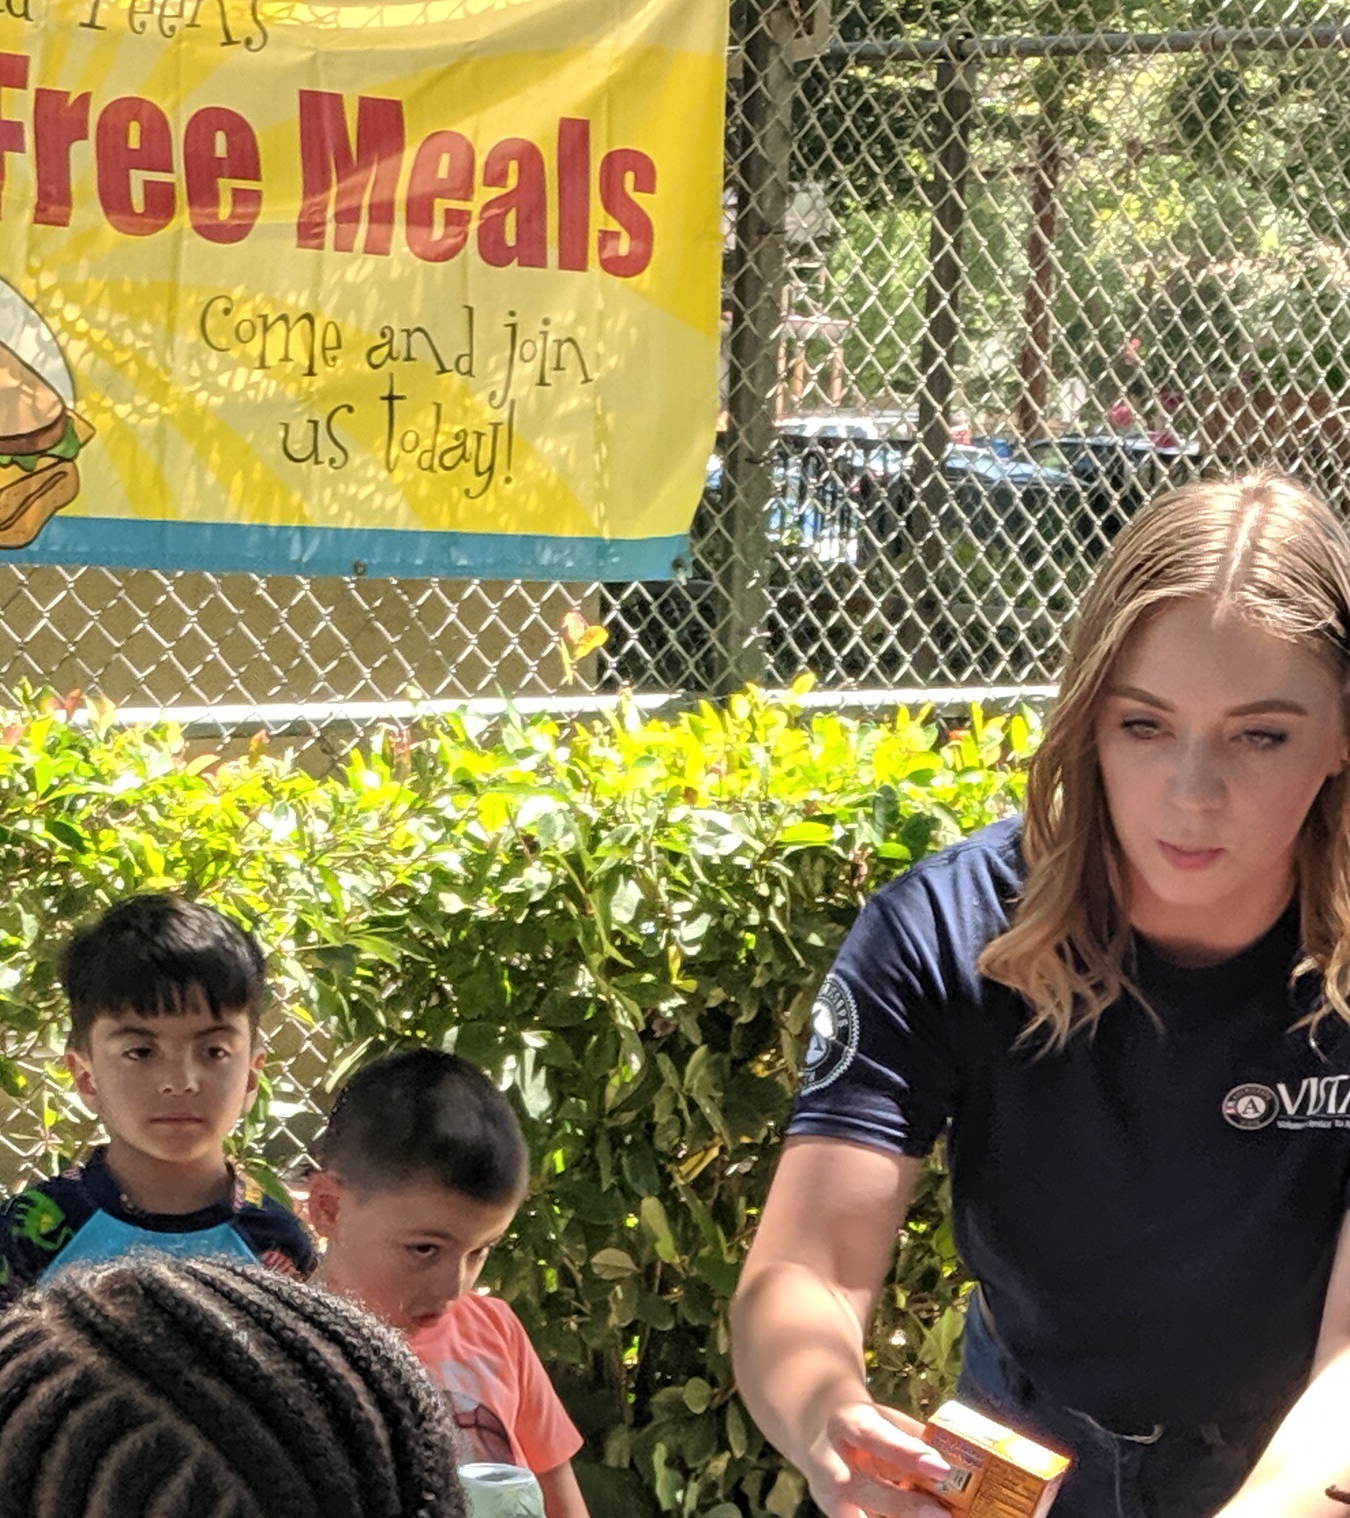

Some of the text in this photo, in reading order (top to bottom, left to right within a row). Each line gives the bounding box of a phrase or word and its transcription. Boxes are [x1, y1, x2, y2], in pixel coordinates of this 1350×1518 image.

[296, 88, 657, 279] Meals
[365, 304, 476, 378] and
[488, 309, 593, 410] join
[279, 372, 515, 500] us today!
